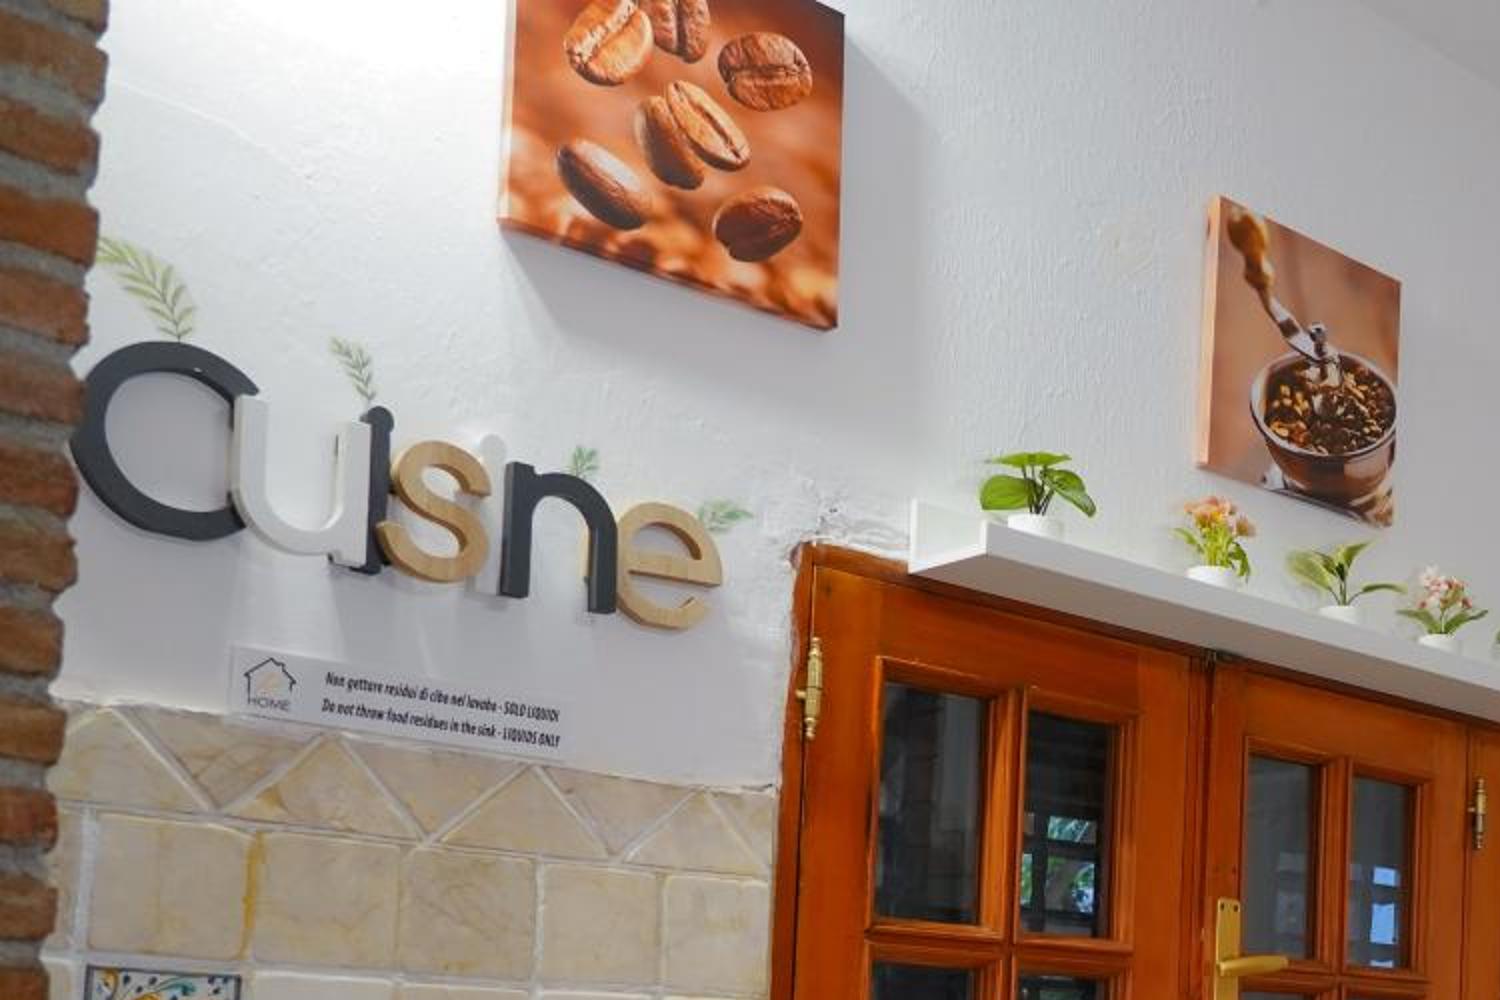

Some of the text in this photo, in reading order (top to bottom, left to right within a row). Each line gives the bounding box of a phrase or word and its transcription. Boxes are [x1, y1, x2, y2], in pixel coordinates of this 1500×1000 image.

[71, 340, 723, 630] Cuisine
[247, 697, 290, 712] HOME
[325, 672, 344, 687] Non
[385, 683, 418, 699] residui
[419, 686, 429, 701] di
[429, 689, 449, 705] cibo
[450, 692, 467, 707] nel
[466, 694, 497, 711] lavabo
[503, 700, 527, 717] SOLO
[321, 698, 336, 713] Do
[337, 703, 355, 716] not
[355, 704, 384, 720] throw
[386, 707, 409, 724] food
[409, 713, 448, 731] residues
[449, 717, 459, 733] in
[460, 720, 476, 735] the
[477, 723, 497, 737] sink
[502, 727, 537, 745] LIQUIDS
[537, 732, 561, 748] ONLY
